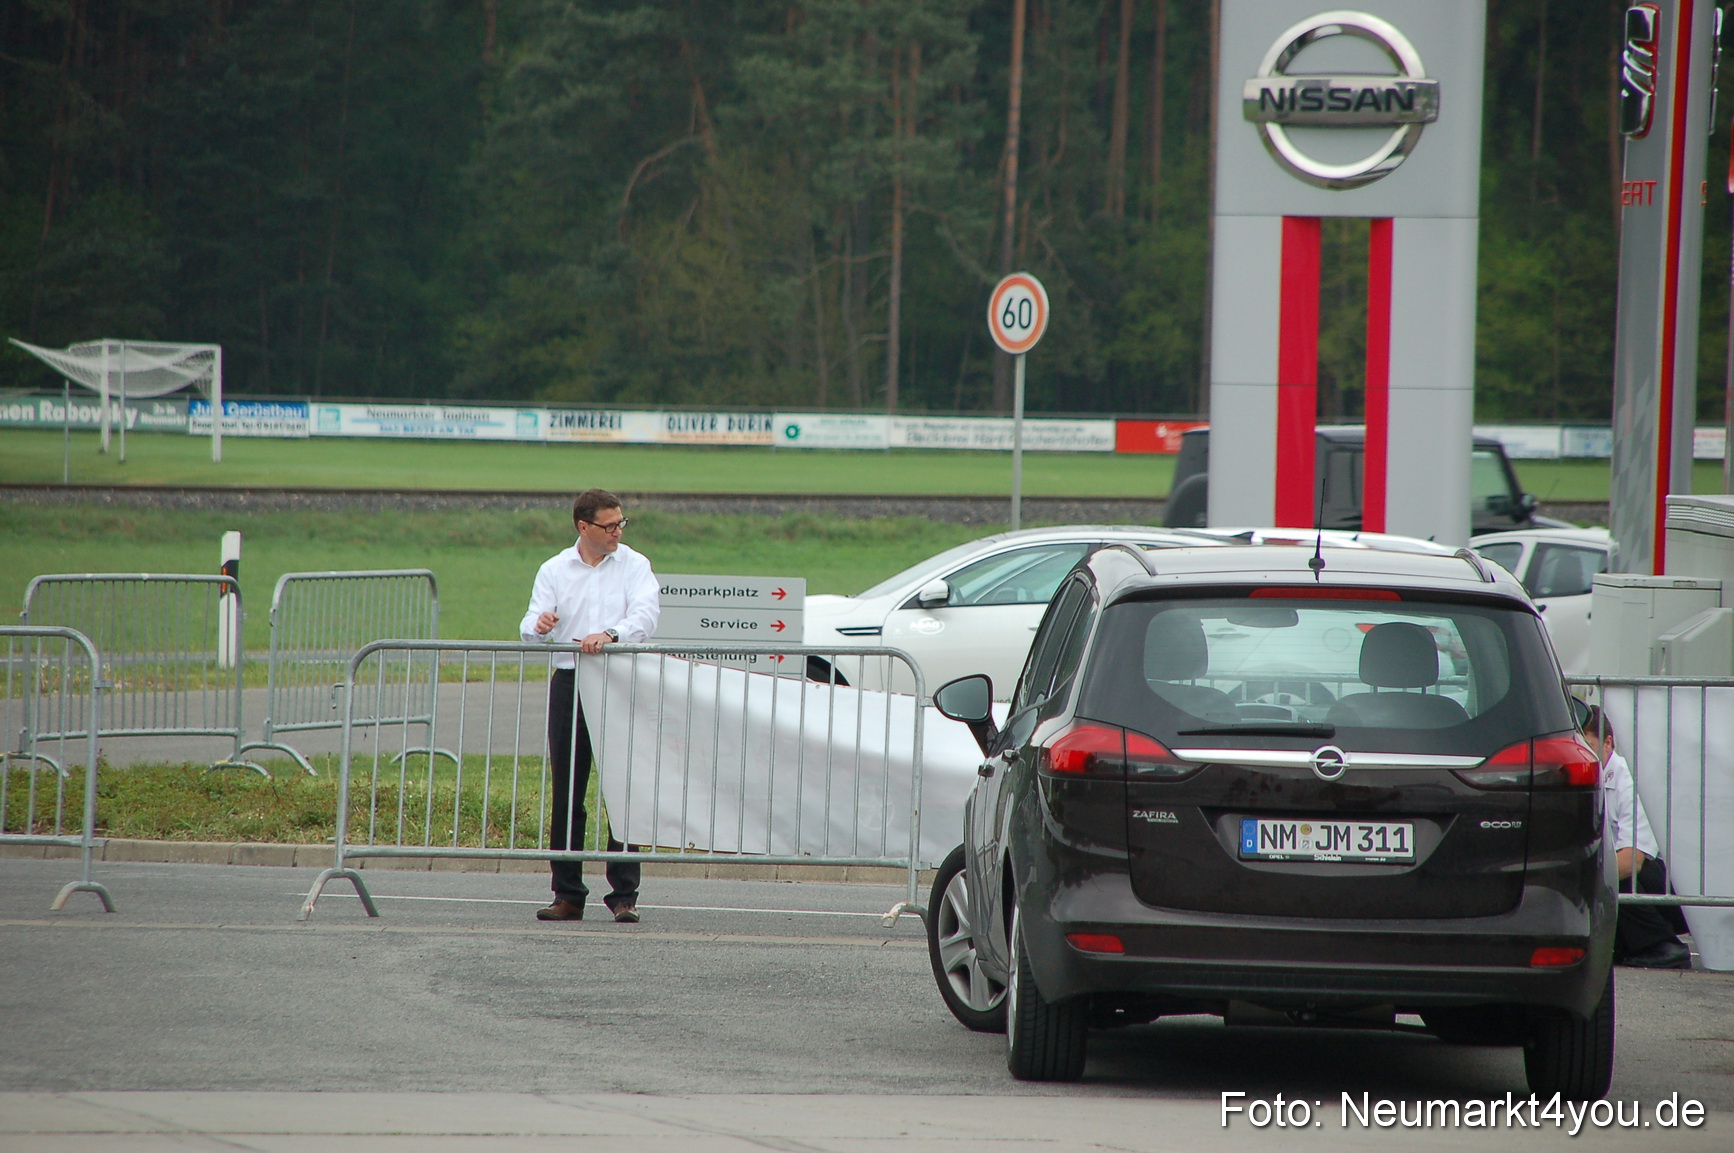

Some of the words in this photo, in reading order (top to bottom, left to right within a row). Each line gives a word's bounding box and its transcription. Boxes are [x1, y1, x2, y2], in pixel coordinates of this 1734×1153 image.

[1259, 87, 1415, 112] NISSAN
[1002, 297, 1032, 329] 60
[550, 410, 622, 429] ZIMMEREI
[667, 413, 718, 432] OLIVER
[660, 585, 759, 599] denparkplatz
[700, 618, 758, 630] Service
[1133, 810, 1177, 819] ZAFIRA
[1246, 839, 1253, 848] D
[1260, 823, 1297, 850] NM
[1315, 824, 1351, 851] JM
[1357, 825, 1410, 853] 311
